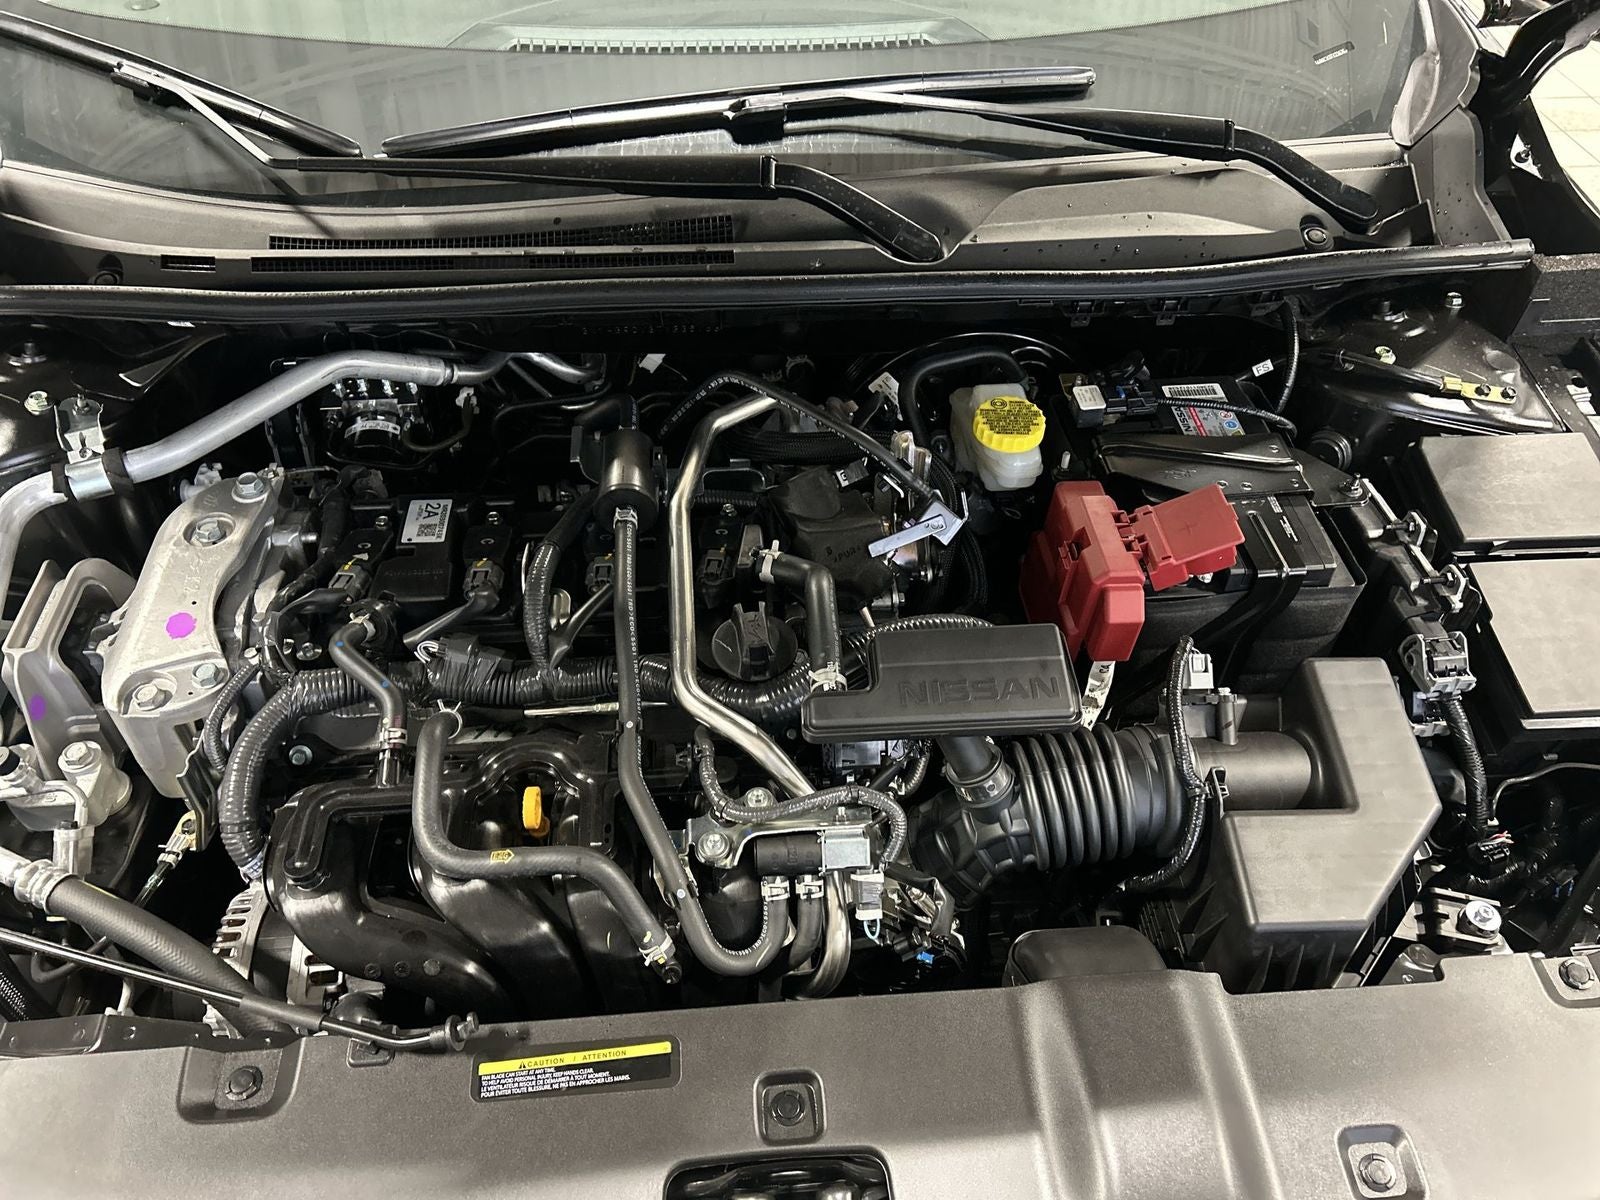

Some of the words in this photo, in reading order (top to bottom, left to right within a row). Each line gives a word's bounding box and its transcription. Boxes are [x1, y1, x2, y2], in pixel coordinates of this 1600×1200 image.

[1256, 364, 1270, 374] FS
[1174, 406, 1192, 432] NISSA
[422, 502, 441, 520] 2A
[900, 676, 1059, 704] NISSAN
[527, 1058, 564, 1068] CAUTION
[582, 1050, 627, 1061] ATTENTION
[488, 1082, 518, 1091] VENTILATEUR
[577, 1078, 604, 1086] APPROCHER
